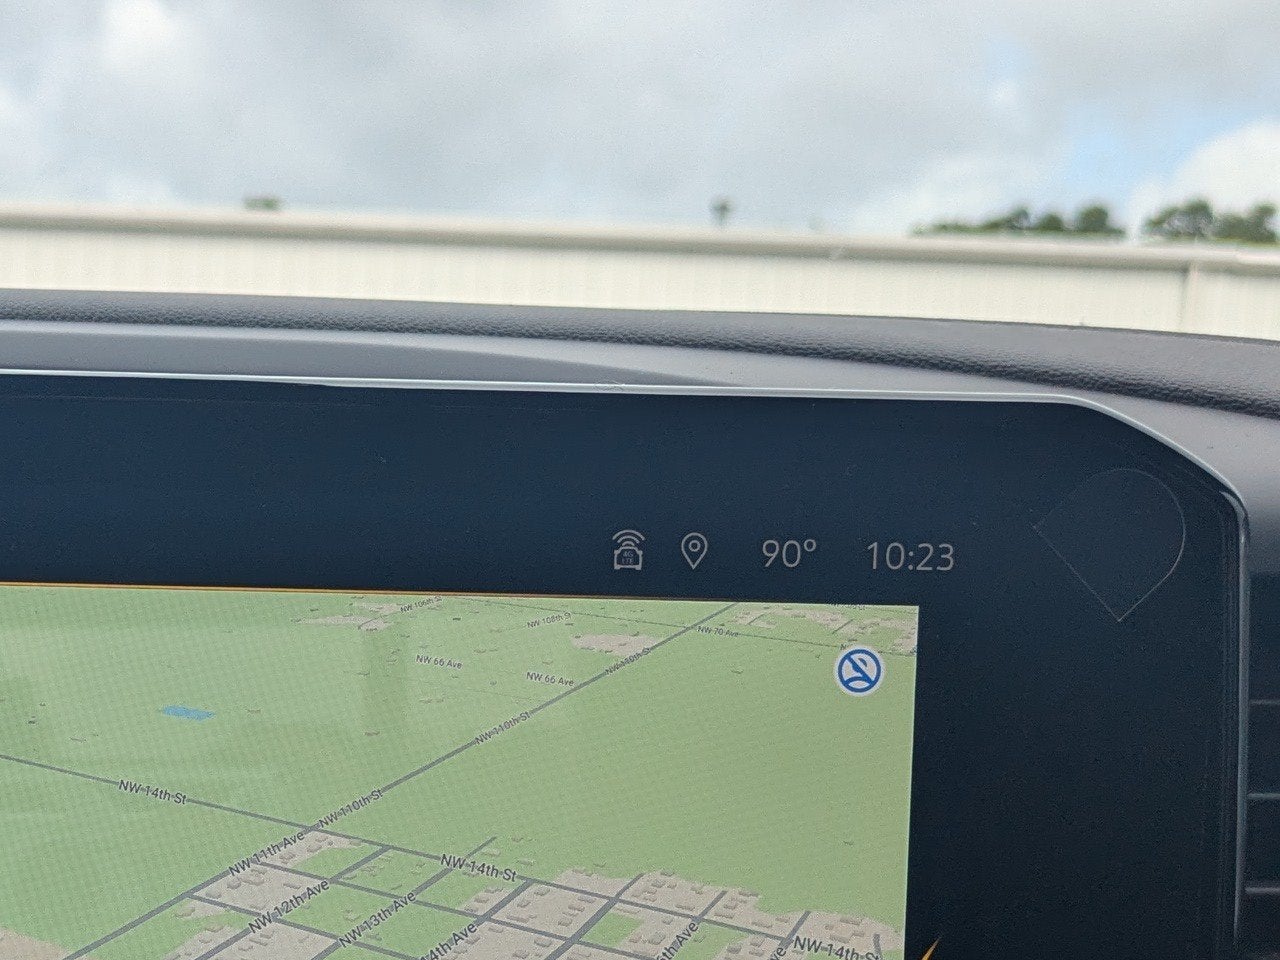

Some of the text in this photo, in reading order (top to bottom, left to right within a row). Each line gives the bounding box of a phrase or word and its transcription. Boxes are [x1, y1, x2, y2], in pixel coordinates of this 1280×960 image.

[762, 539, 816, 568] 90°
[867, 541, 955, 571] 10:23
[416, 653, 462, 670] NW 66 Ave
[526, 671, 574, 688] NW 66 Ave
[474, 730, 492, 745] NW
[520, 711, 531, 722] St
[118, 778, 187, 806] NW 14th St
[319, 788, 384, 829] NW 110th St
[228, 829, 306, 877] NW 11th Ave
[440, 853, 517, 883] NW 14th St
[248, 878, 331, 934] NW 12th Ave
[338, 890, 417, 949] NW 13th Ave
[450, 922, 478, 945] Ave
[675, 920, 699, 949] Ave
[793, 935, 821, 954] NW
